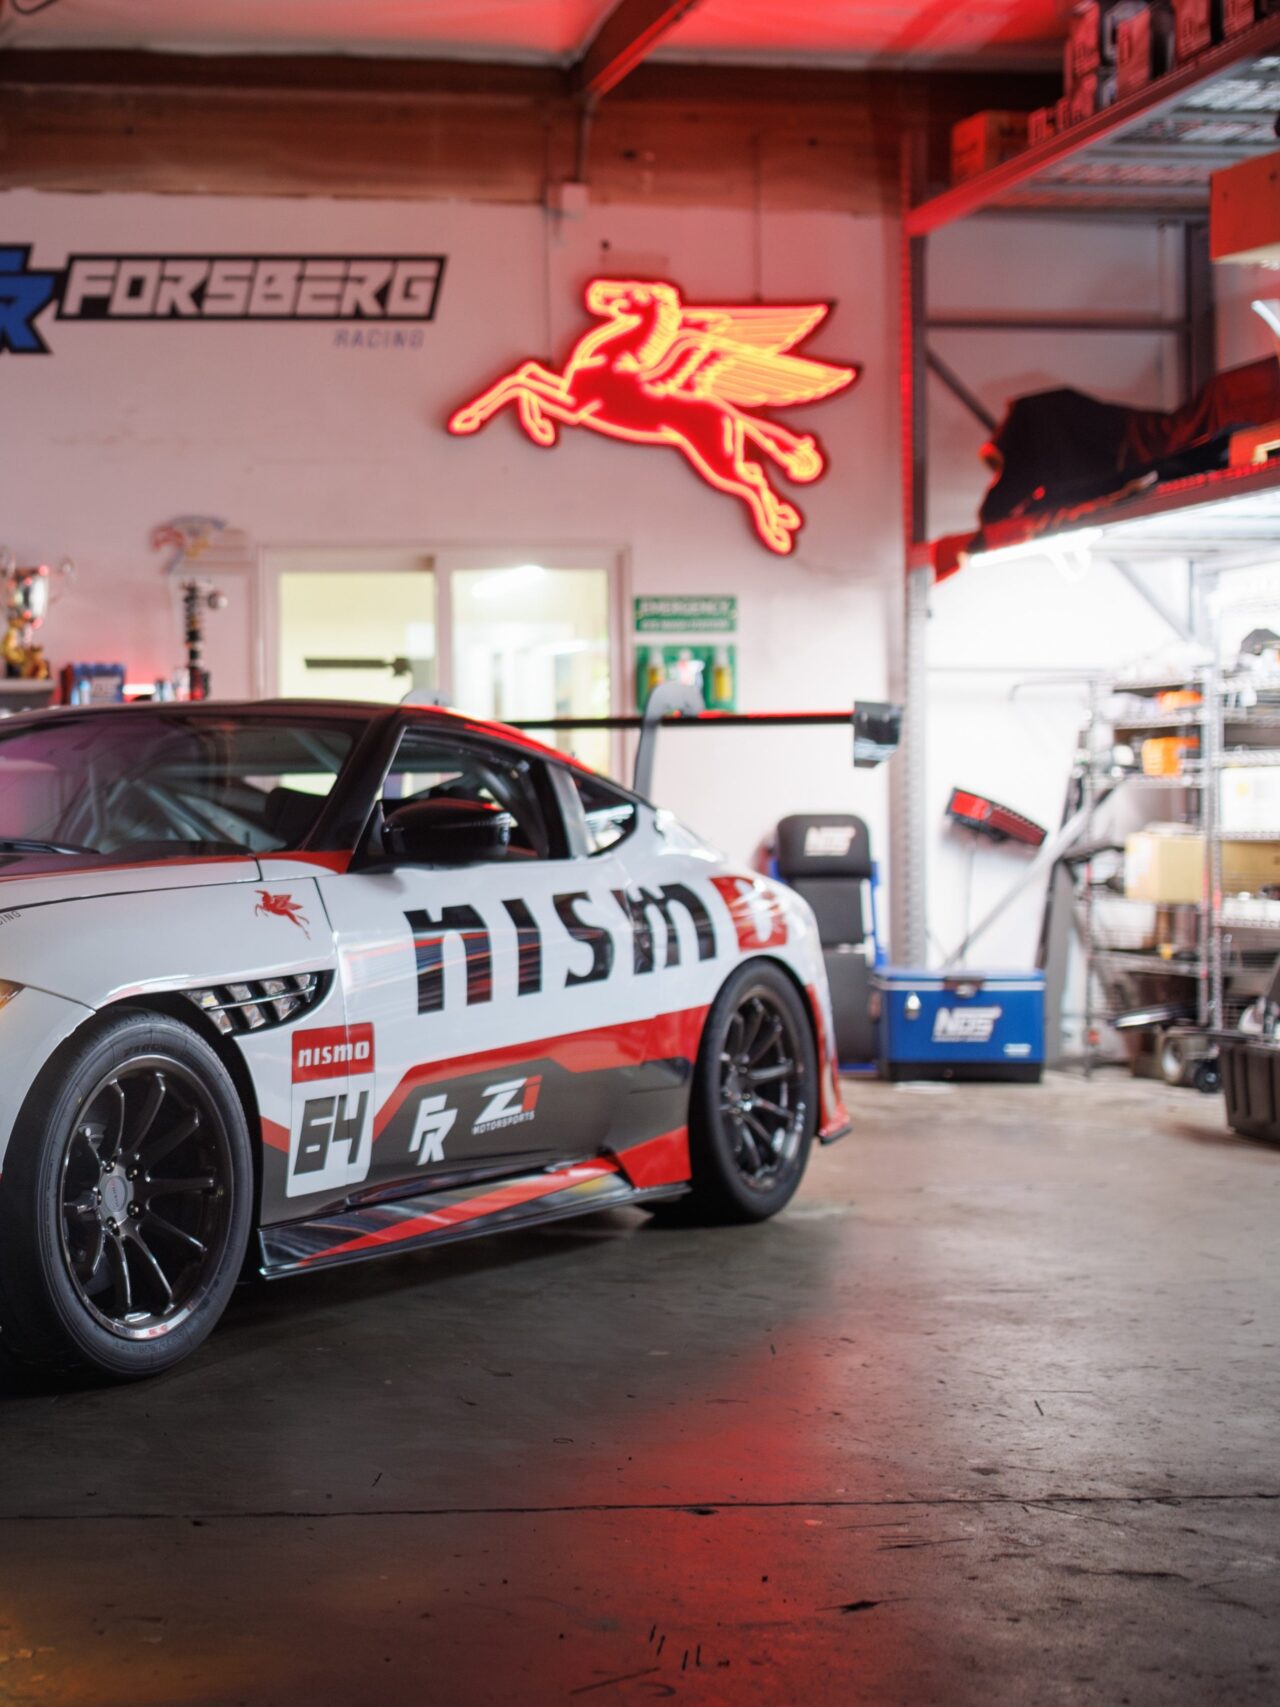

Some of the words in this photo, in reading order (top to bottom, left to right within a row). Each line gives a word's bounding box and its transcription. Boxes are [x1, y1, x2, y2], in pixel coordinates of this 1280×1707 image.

[58, 256, 445, 320] FORSBERG
[334, 328, 425, 351] RACING
[298, 1040, 370, 1068] nismo
[293, 1090, 369, 1176] 64
[471, 1109, 536, 1135] MOTORSPORTS
